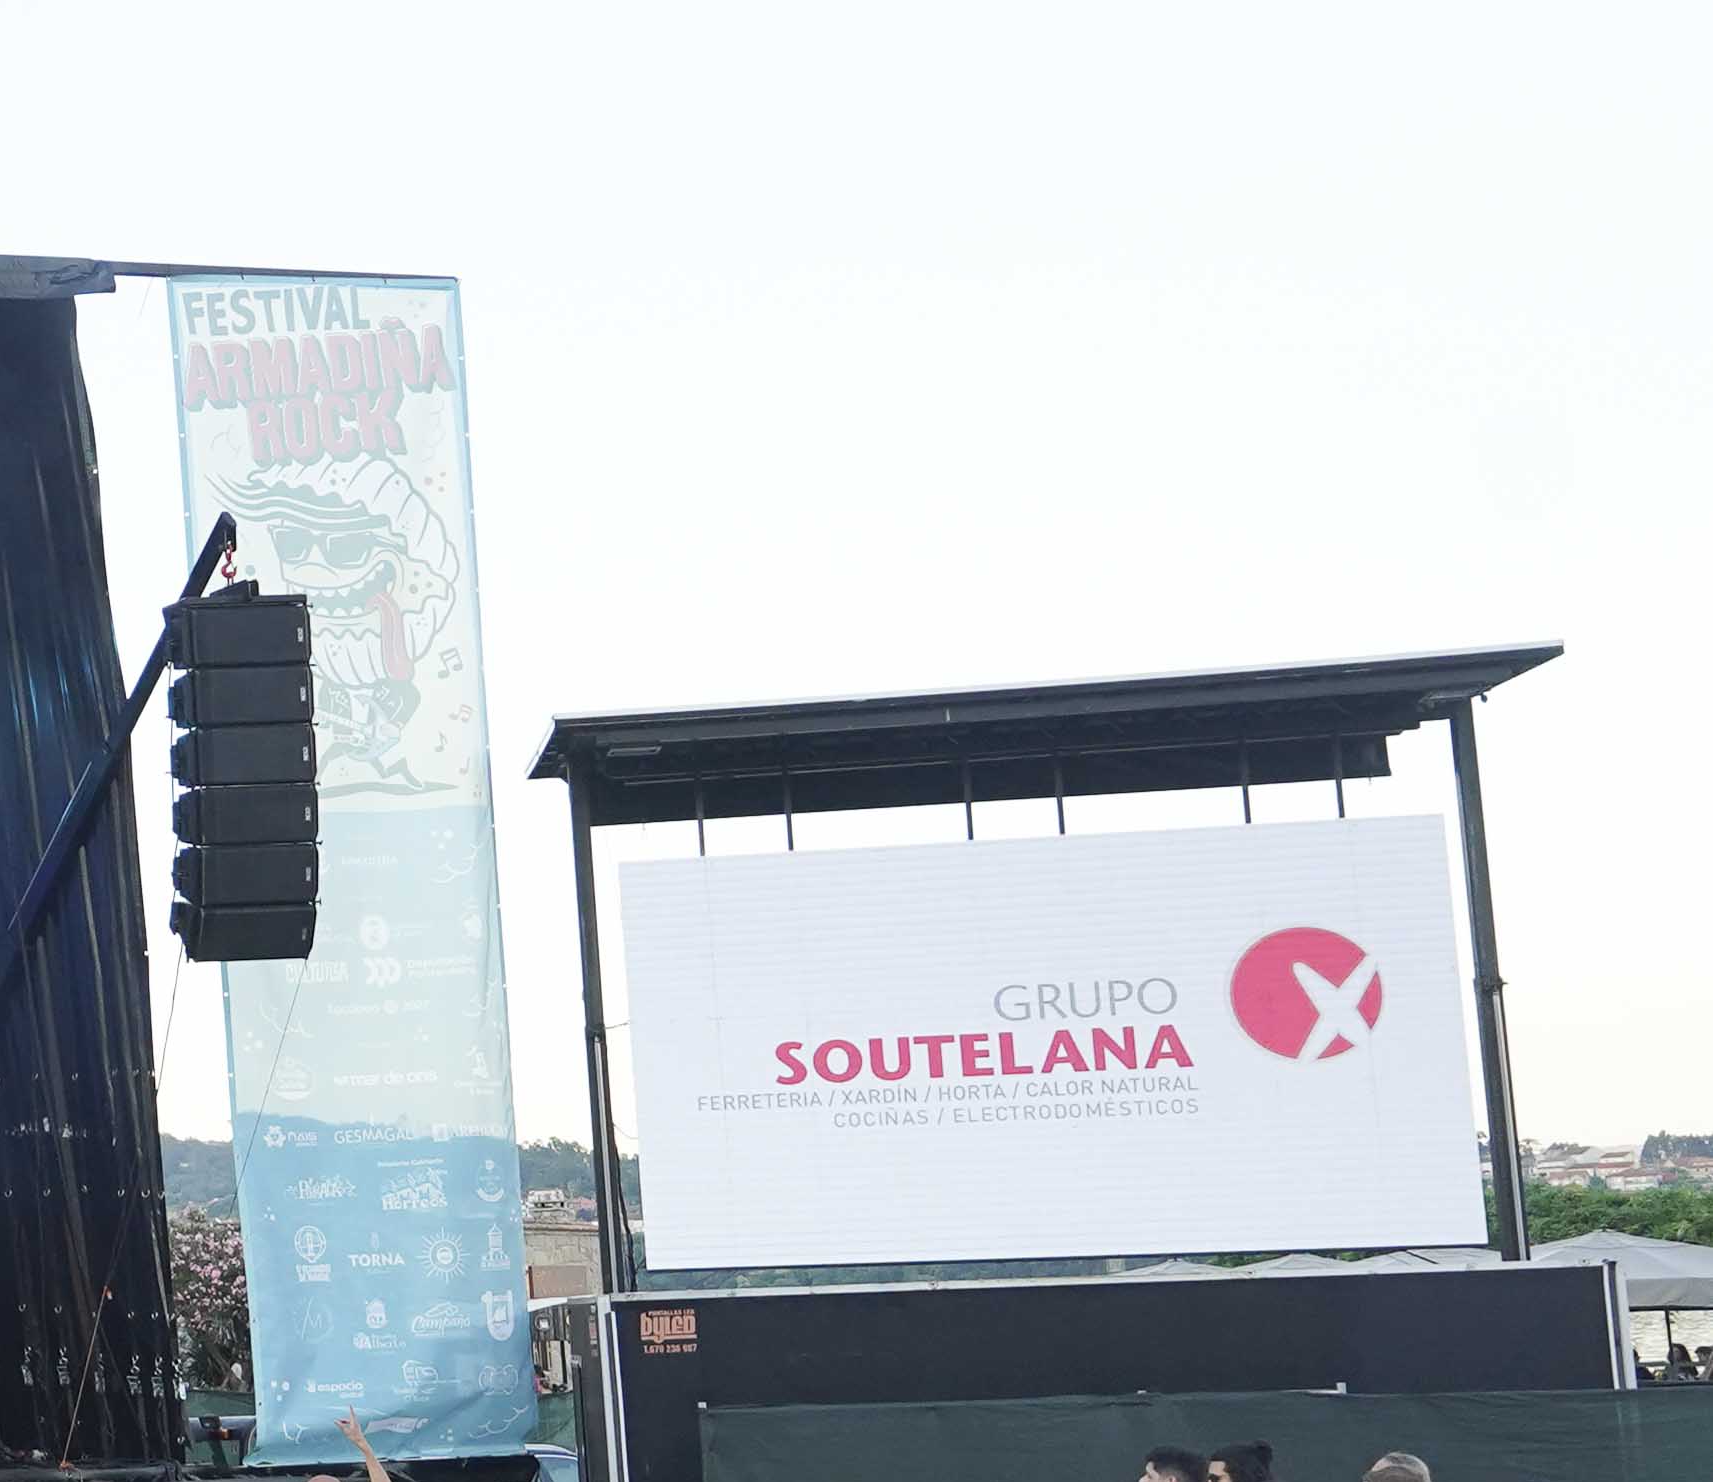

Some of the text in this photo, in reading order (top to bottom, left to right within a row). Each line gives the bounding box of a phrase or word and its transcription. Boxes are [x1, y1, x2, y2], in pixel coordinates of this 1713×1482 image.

[182, 287, 370, 335] FESTIVAL
[183, 317, 457, 412] ARMADIÑA
[246, 390, 406, 465] ROCK
[993, 977, 1178, 1022] GRUPO
[775, 1024, 1194, 1086] SOUTELANA
[697, 1092, 823, 1113] FERRETERIA
[842, 1085, 918, 1104] XARDÍN
[938, 1083, 1007, 1102] HORTA
[1025, 1079, 1095, 1098] CALOR
[1101, 1075, 1199, 1095] NATURAL
[833, 1107, 929, 1129] COCIÑAS
[953, 1097, 1200, 1124] ELECTRODOMÉSTICOS
[348, 1252, 406, 1268] TORNA
